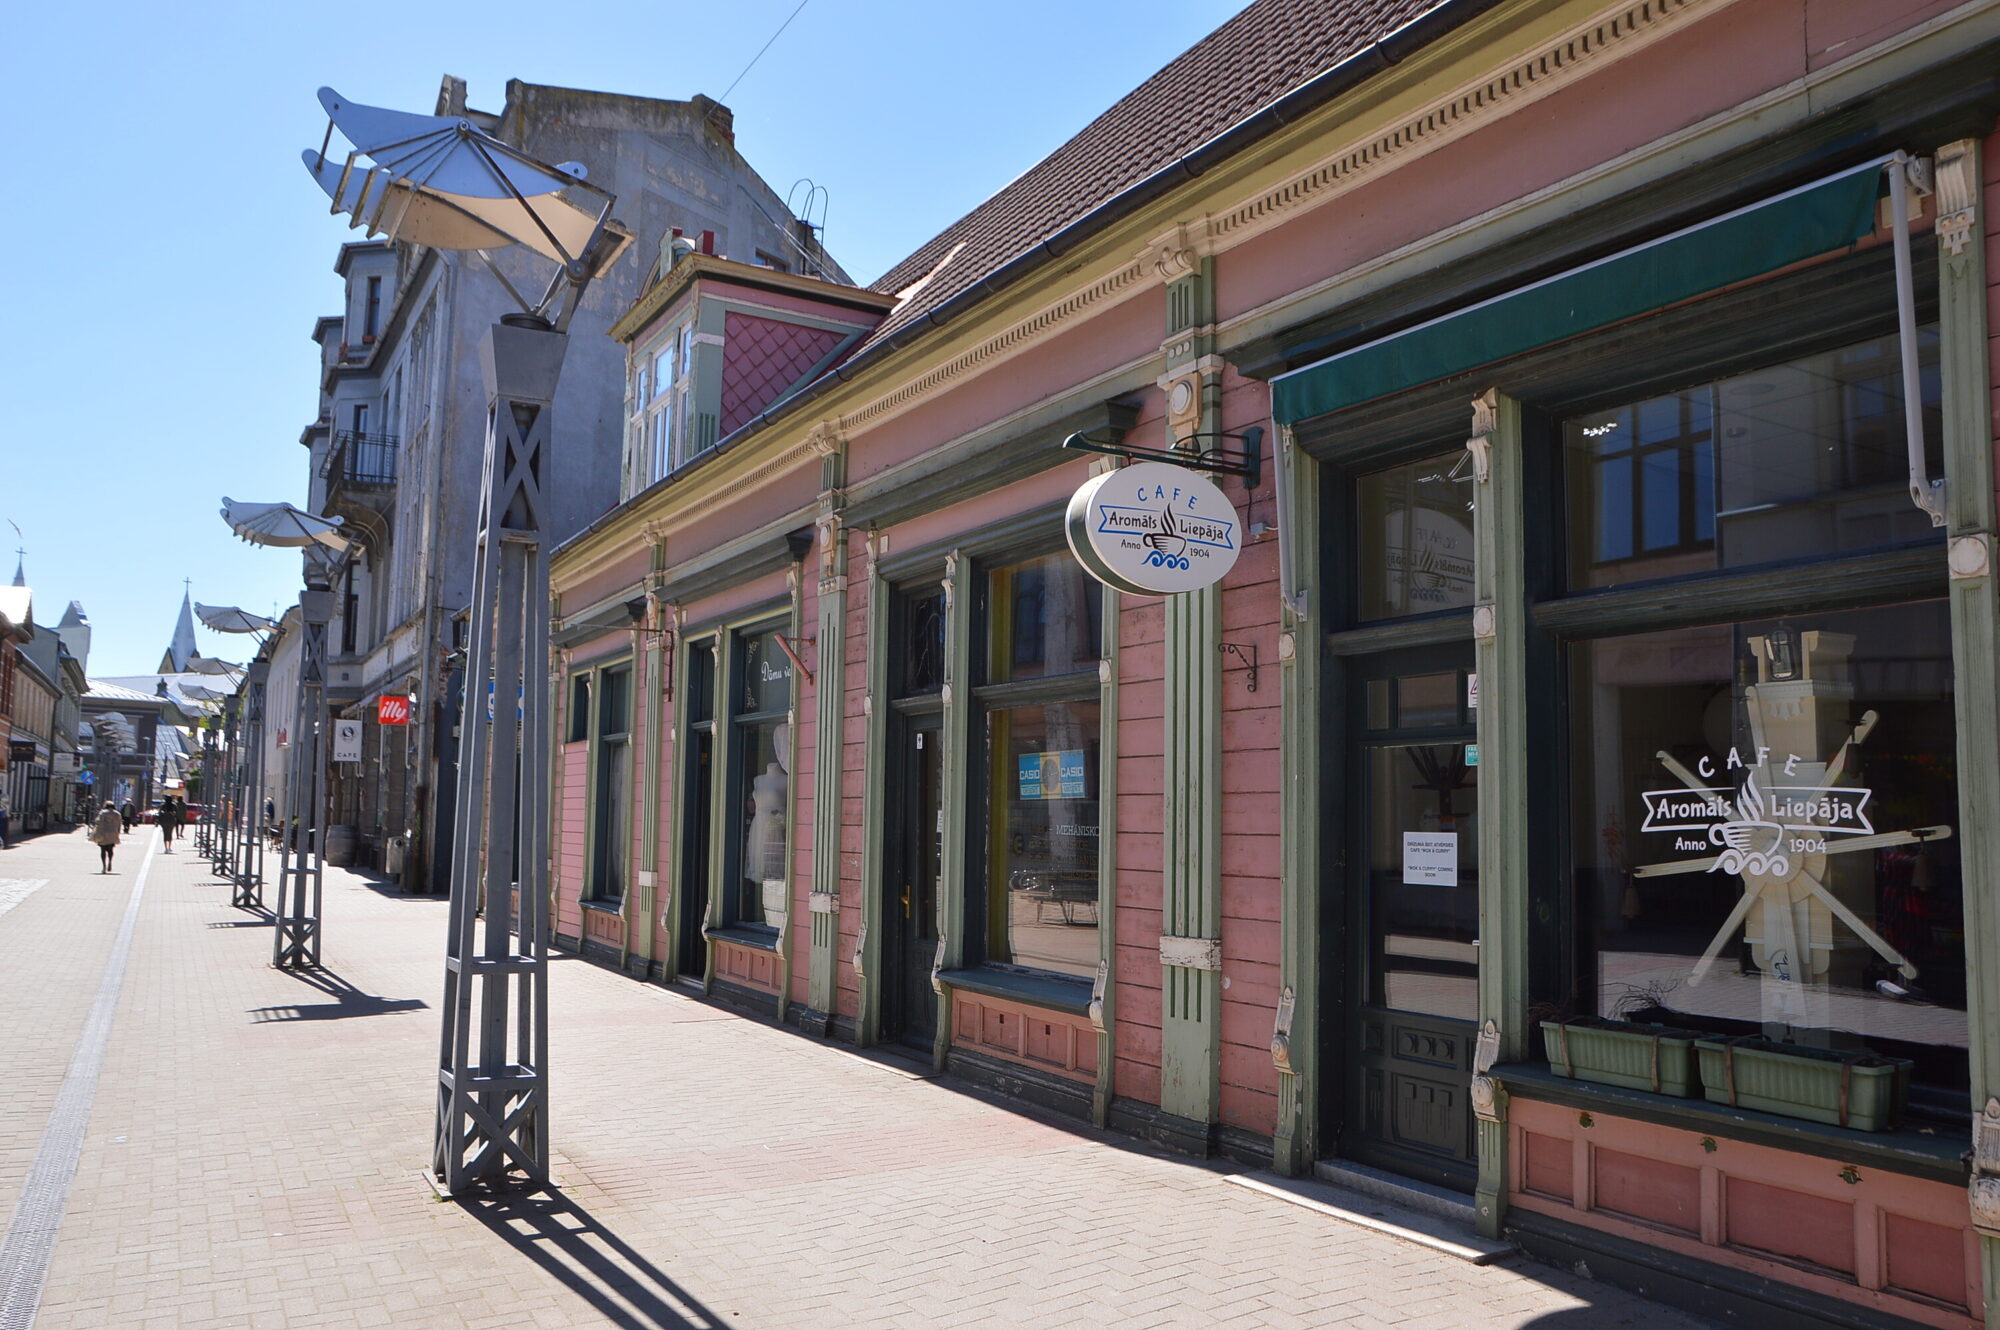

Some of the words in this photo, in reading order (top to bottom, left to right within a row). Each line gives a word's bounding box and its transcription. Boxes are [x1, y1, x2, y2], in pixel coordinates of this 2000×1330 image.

[1138, 484, 1198, 510] CAFE
[1108, 511, 1157, 530] Aromāts
[1179, 518, 1224, 542] Liepāja
[1120, 538, 1141, 550] Anno
[1190, 547, 1210, 559] 1904
[380, 700, 407, 723] illy
[1060, 766, 1084, 778] CASIO
[1698, 746, 1802, 778] CAFE
[1019, 769, 1040, 780] CASIO
[1656, 794, 1732, 820] Aromāts
[1771, 796, 1853, 825] Liepāja
[1675, 836, 1707, 851] Anno
[1789, 838, 1827, 854] 1904
